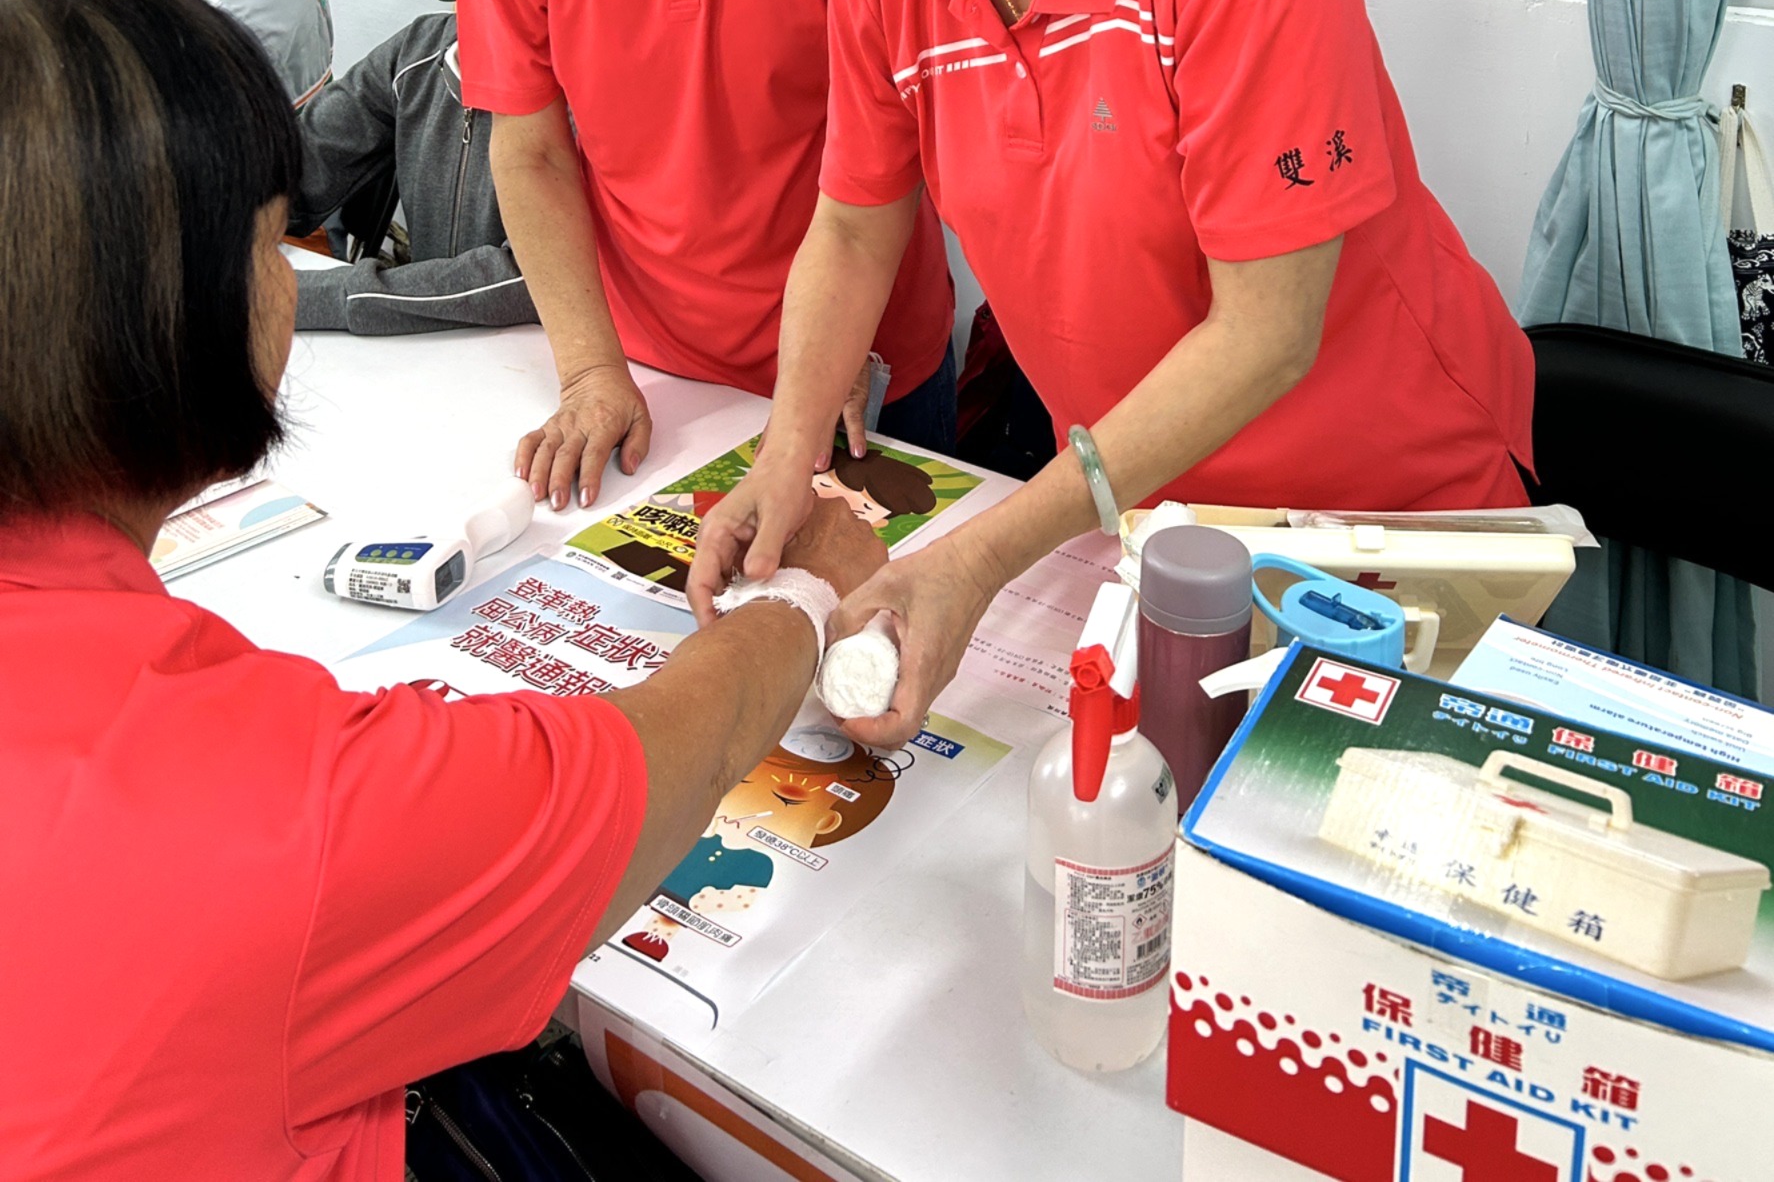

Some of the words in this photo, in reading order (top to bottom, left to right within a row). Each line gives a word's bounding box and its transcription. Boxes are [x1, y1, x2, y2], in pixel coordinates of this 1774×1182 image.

[1273, 129, 1354, 191] 雙溪
[507, 578, 601, 622] 登革熱
[471, 597, 569, 646] 屈公病
[1513, 635, 1599, 669] Thermometer
[1533, 672, 1560, 686] Easily
[1601, 666, 1655, 689] Infrared
[1589, 704, 1626, 720] alarm
[1659, 685, 1743, 720] Non-contact
[1627, 718, 1710, 753] temperature
[1726, 733, 1750, 746] Data
[1552, 727, 1763, 800] 保健箱
[1714, 748, 1741, 763] High
[830, 783, 856, 802] 頭痛
[1547, 744, 1638, 777] FIRST
[1643, 772, 1699, 795] AID
[1706, 789, 1760, 811] KIT
[1445, 859, 1607, 942] 保健箱
[654, 898, 736, 946] 骨頭關節肌肉痛
[1362, 982, 1642, 1112] 保健箱
[1362, 1016, 1475, 1072] FIRST
[1486, 1069, 1556, 1104] AID
[1570, 1098, 1640, 1131] KIT
